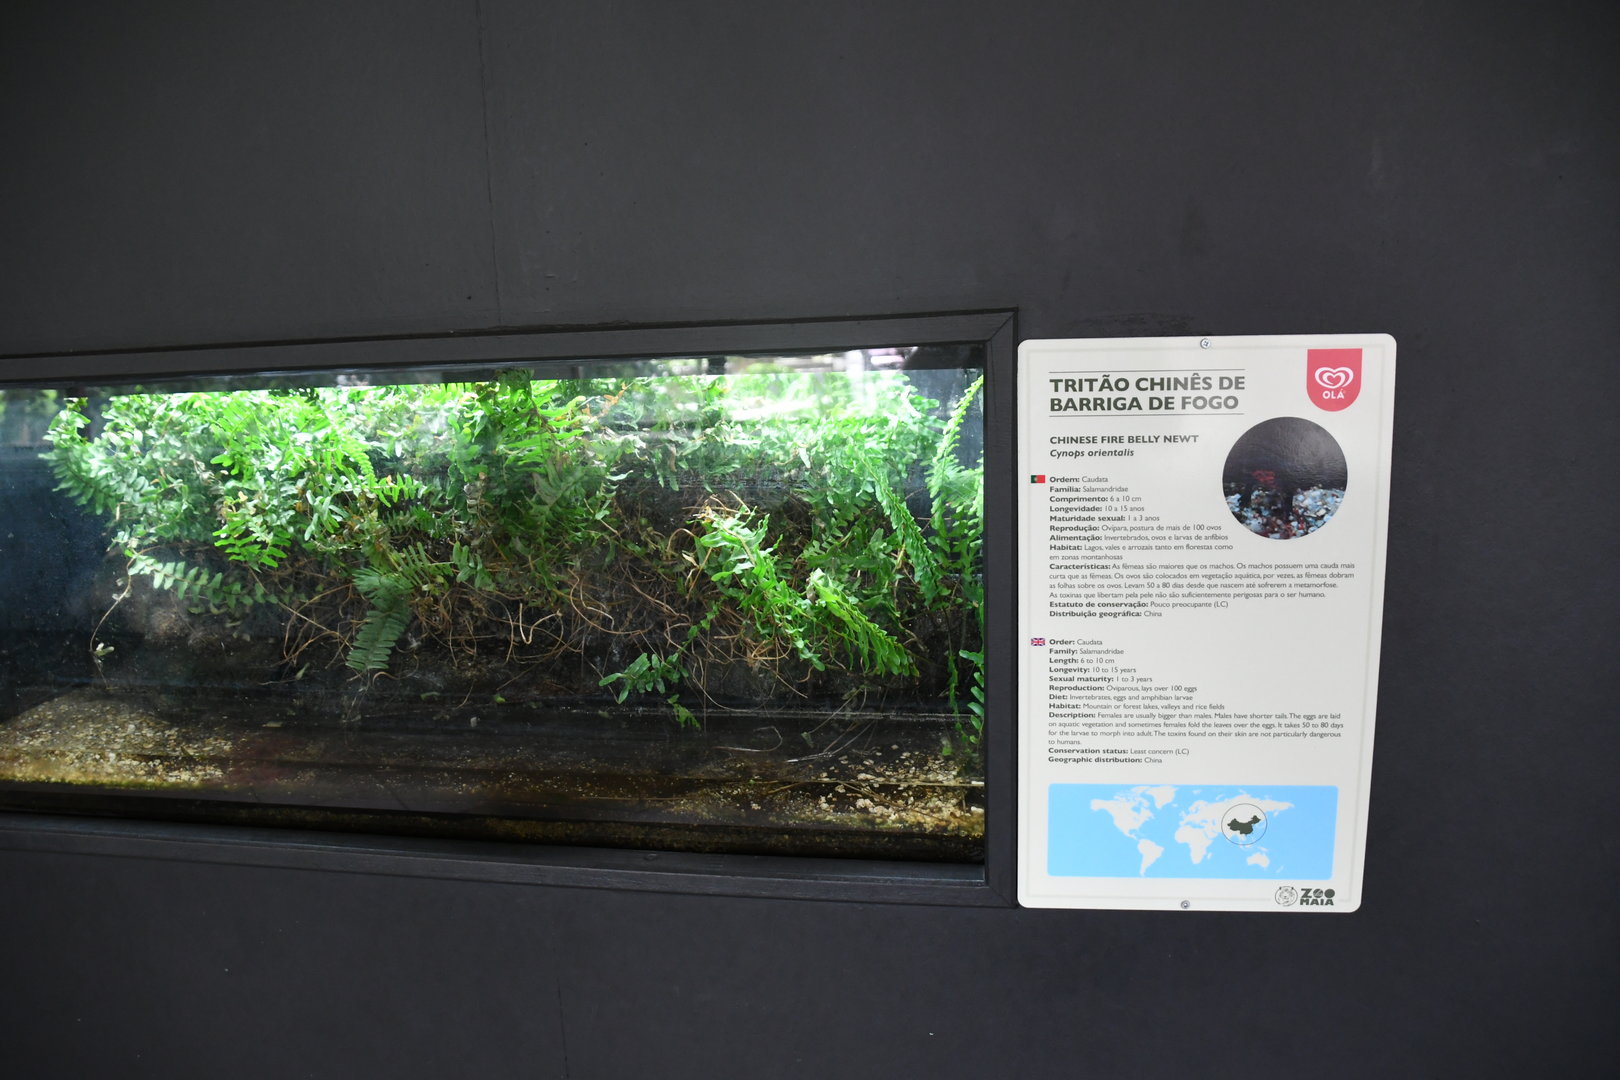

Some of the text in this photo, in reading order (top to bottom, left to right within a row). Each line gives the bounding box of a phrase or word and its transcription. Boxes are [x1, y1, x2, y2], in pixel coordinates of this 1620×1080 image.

[1049, 372, 1244, 392] TRITÃO CHINÊS DE
[1050, 395, 1238, 411] BARRIGA DE FOGO
[1049, 434, 1198, 444] CHINESE FIRE BELLY NEWT
[1049, 448, 1134, 459] Cynops orientalis
[1213, 600, 1228, 609] (LC)
[1330, 722, 1344, 730] days
[1174, 748, 1189, 756] (LC)
